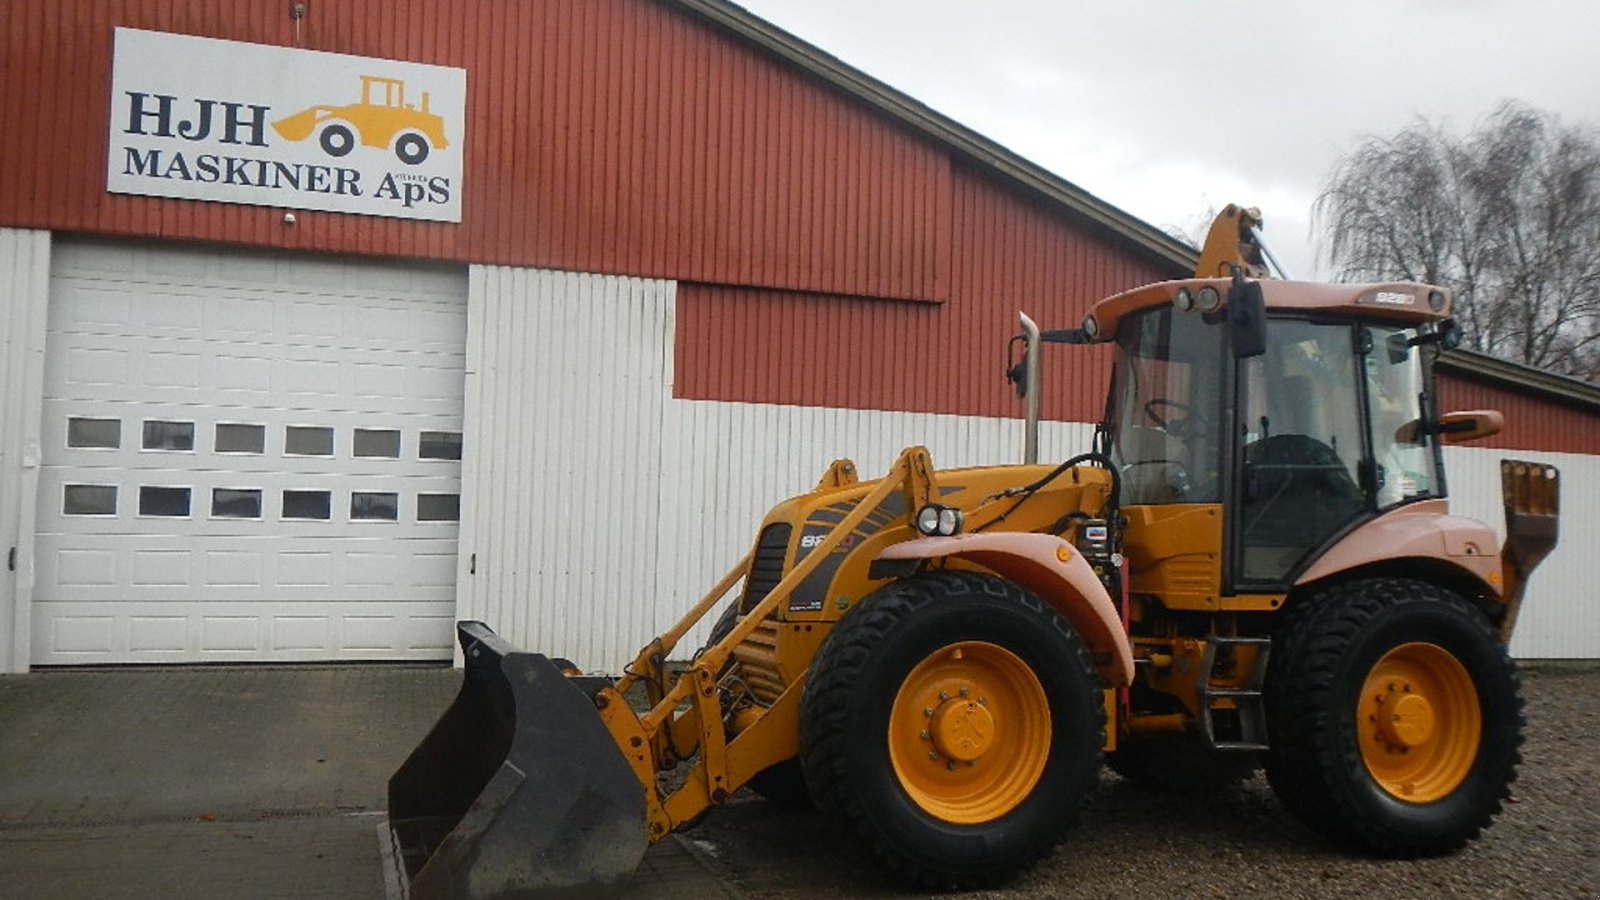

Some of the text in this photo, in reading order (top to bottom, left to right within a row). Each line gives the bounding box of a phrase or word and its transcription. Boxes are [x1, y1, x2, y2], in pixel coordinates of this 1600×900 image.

[123, 91, 271, 147] HJH
[122, 147, 450, 208] MASKINER ApS
